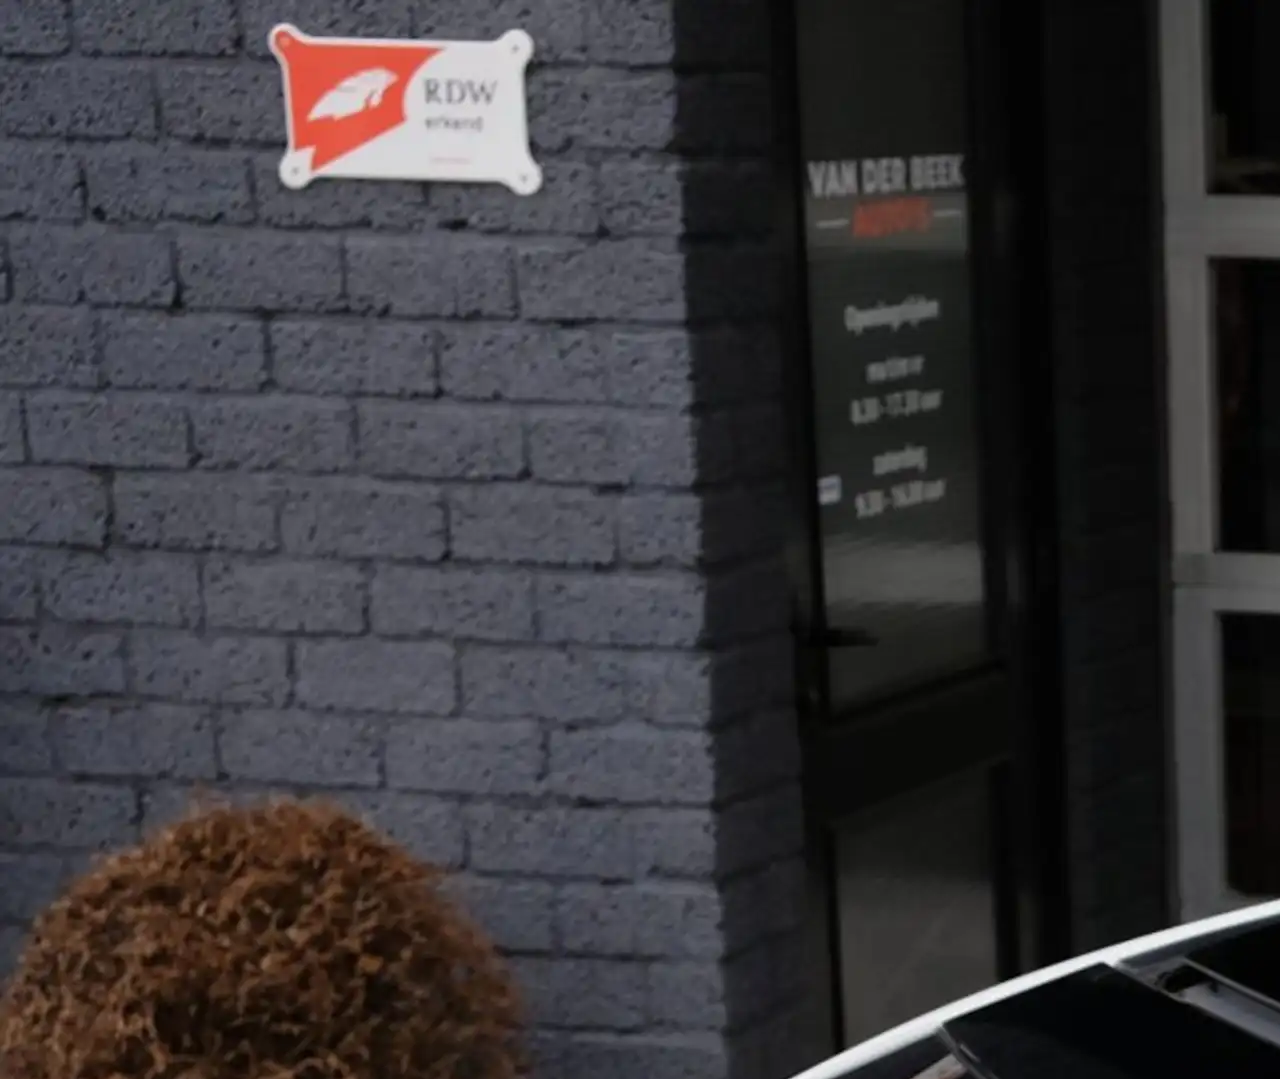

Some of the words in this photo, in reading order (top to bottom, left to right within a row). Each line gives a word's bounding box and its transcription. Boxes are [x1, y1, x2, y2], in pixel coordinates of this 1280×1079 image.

[424, 78, 498, 105] RDW
[424, 114, 484, 132] erkend
[807, 161, 858, 200] VAN
[861, 157, 906, 196] DER
[909, 154, 965, 192] BEEK
